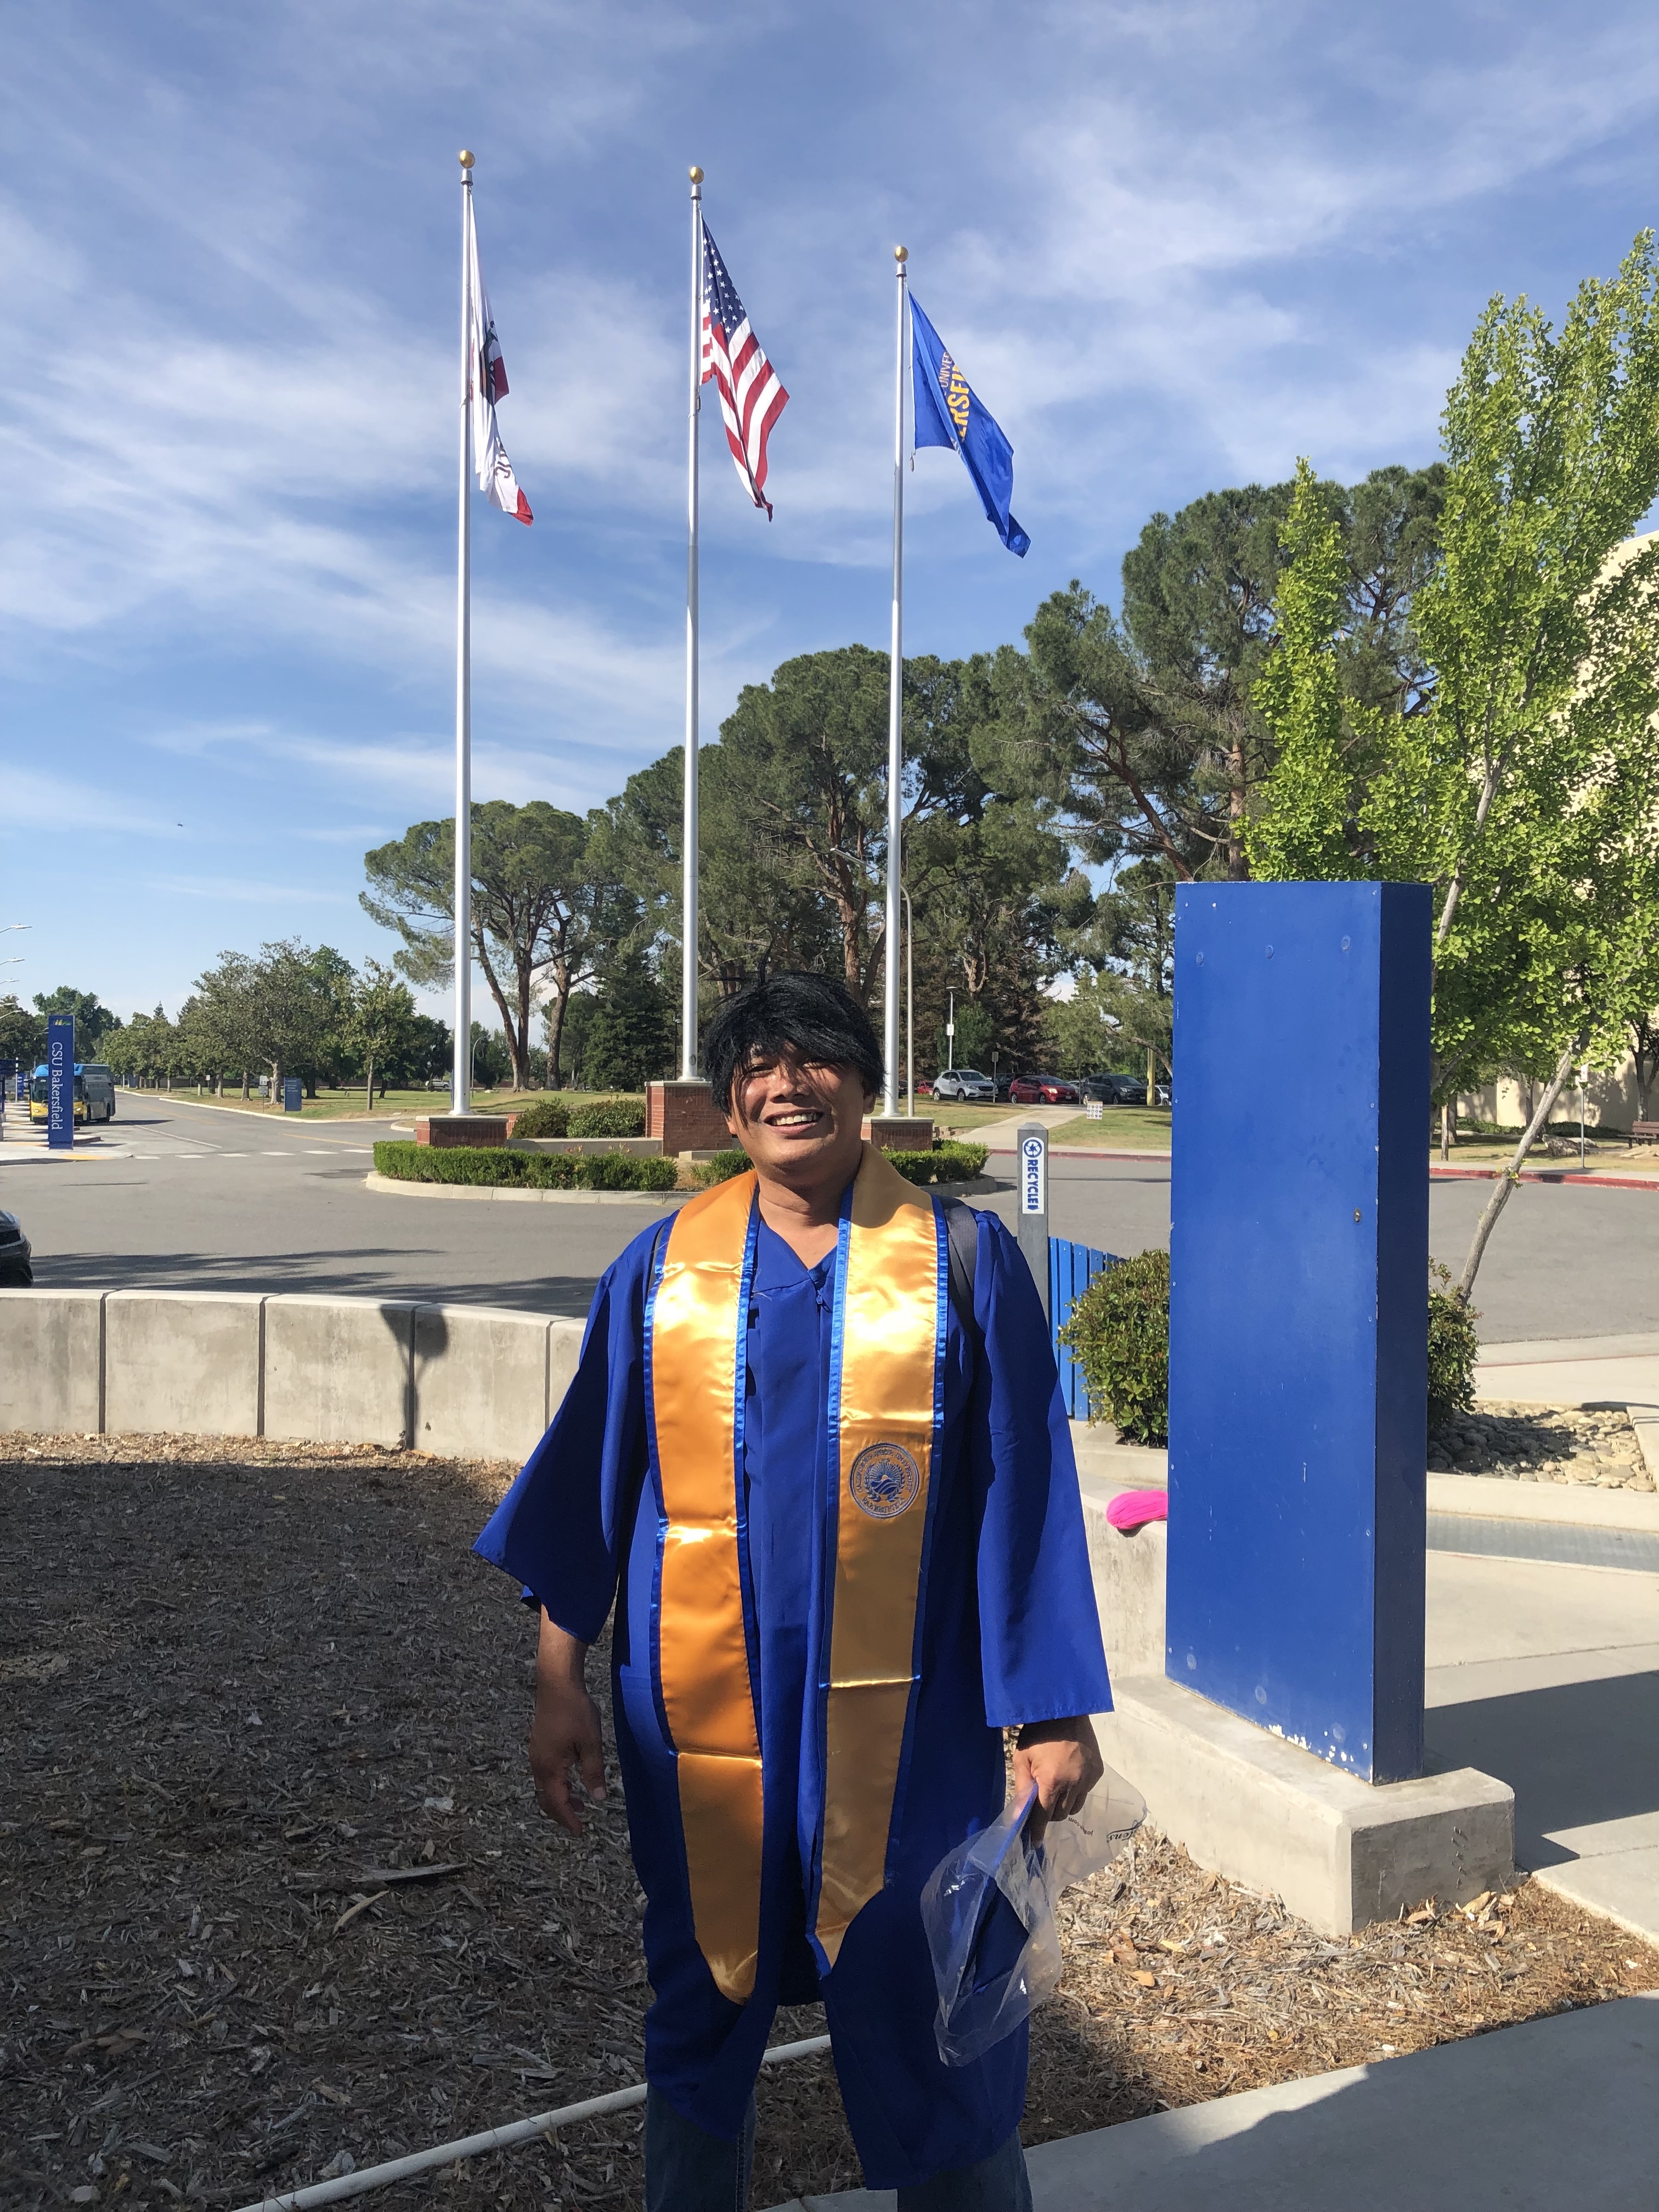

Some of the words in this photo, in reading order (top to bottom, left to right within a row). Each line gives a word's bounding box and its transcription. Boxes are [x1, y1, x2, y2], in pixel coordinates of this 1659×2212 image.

[52, 1042, 63, 1066] CSU
[52, 1069, 64, 1130] Bakersfield
[1027, 1159, 1039, 1204] RECYCLE
